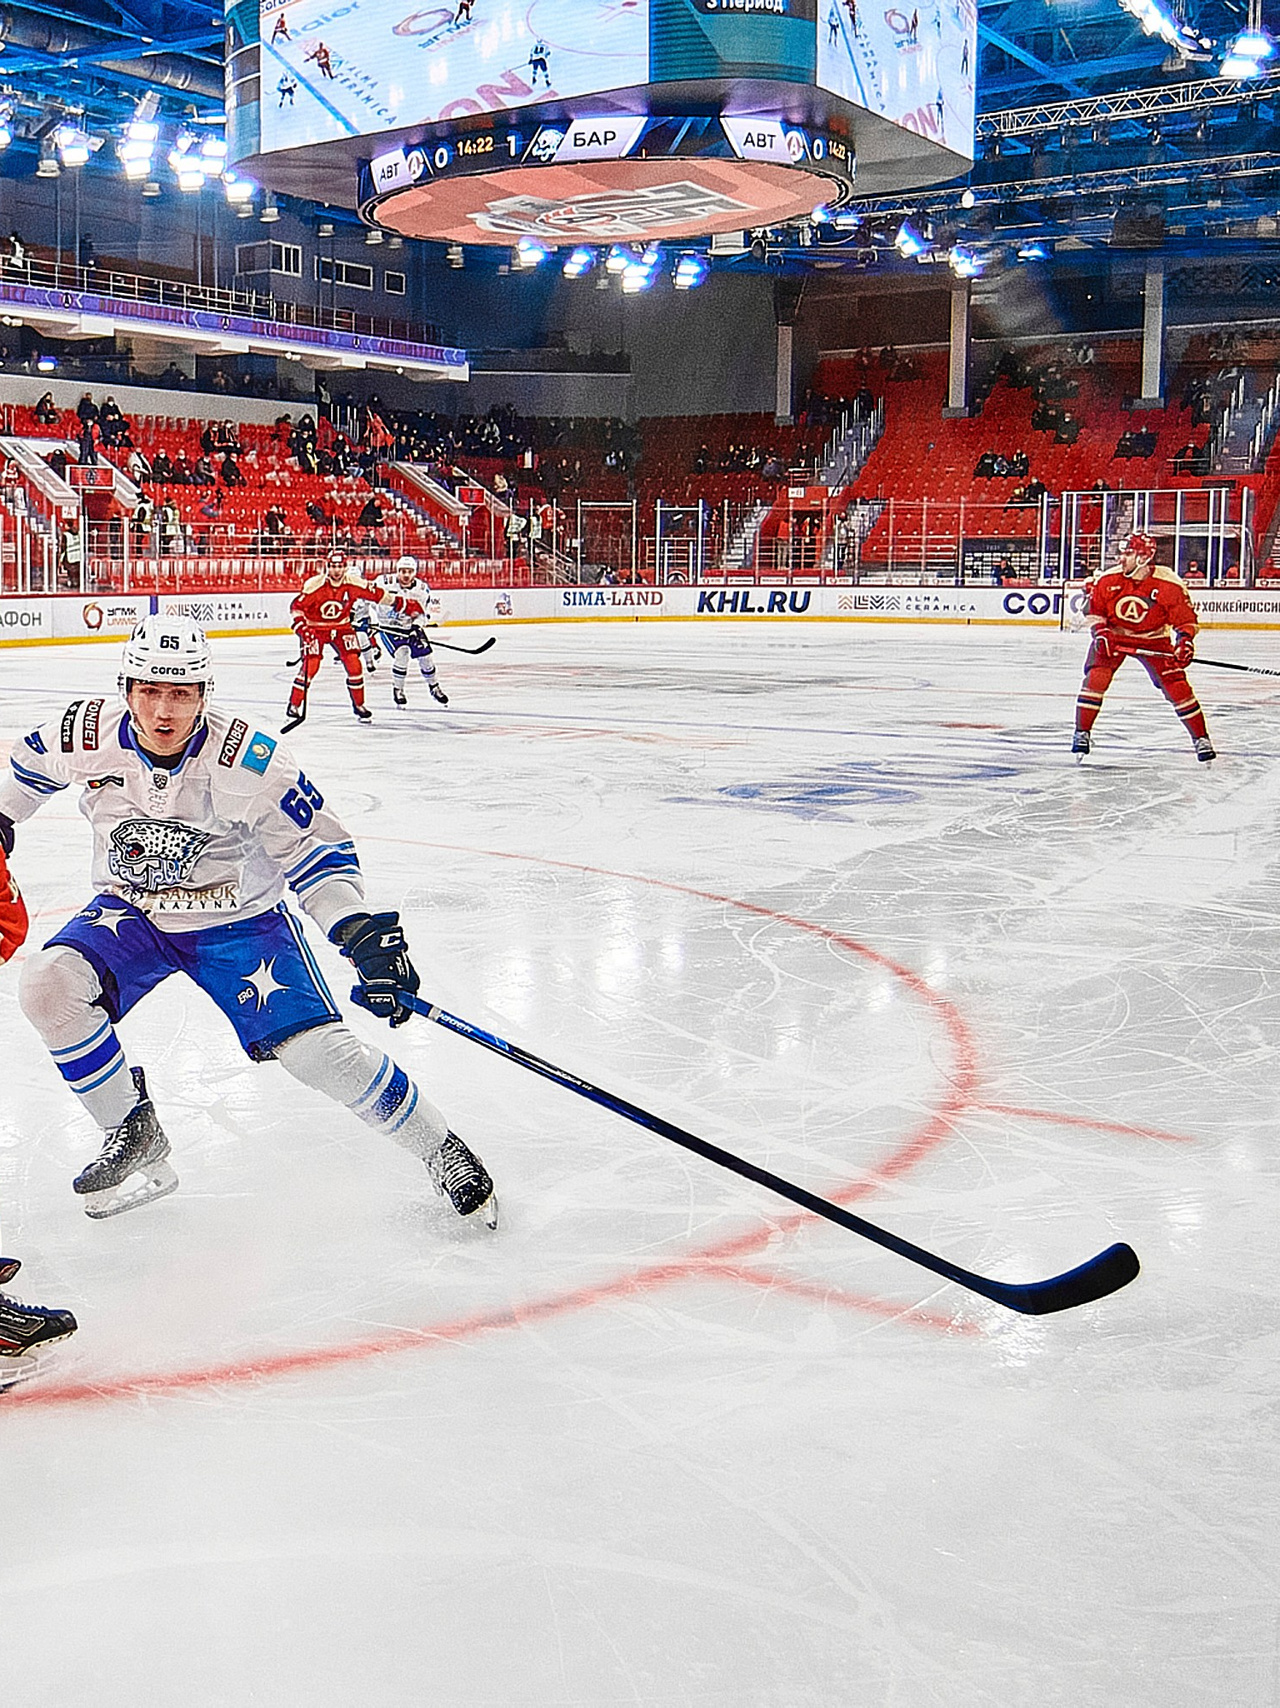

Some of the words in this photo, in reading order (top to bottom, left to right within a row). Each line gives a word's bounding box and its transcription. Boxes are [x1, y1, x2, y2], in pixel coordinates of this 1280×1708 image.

[456, 137, 495, 157] 14:22
[506, 134, 517, 157] 1
[572, 130, 617, 148] БАР
[743, 132, 777, 149] АВТ
[434, 147, 448, 169] 0
[813, 138, 823, 160] 0
[562, 591, 664, 607] SIMA-LAND
[696, 590, 812, 613] KHL.RU
[906, 604, 976, 612] CERAMICA
[217, 612, 269, 622] CERAMICA
[160, 635, 180, 650] 65
[84, 700, 102, 749] FONBET
[221, 720, 246, 766] FONBET
[279, 768, 325, 830] 65
[159, 900, 238, 911] KAZYNA
[236, 986, 256, 1005] ERG
